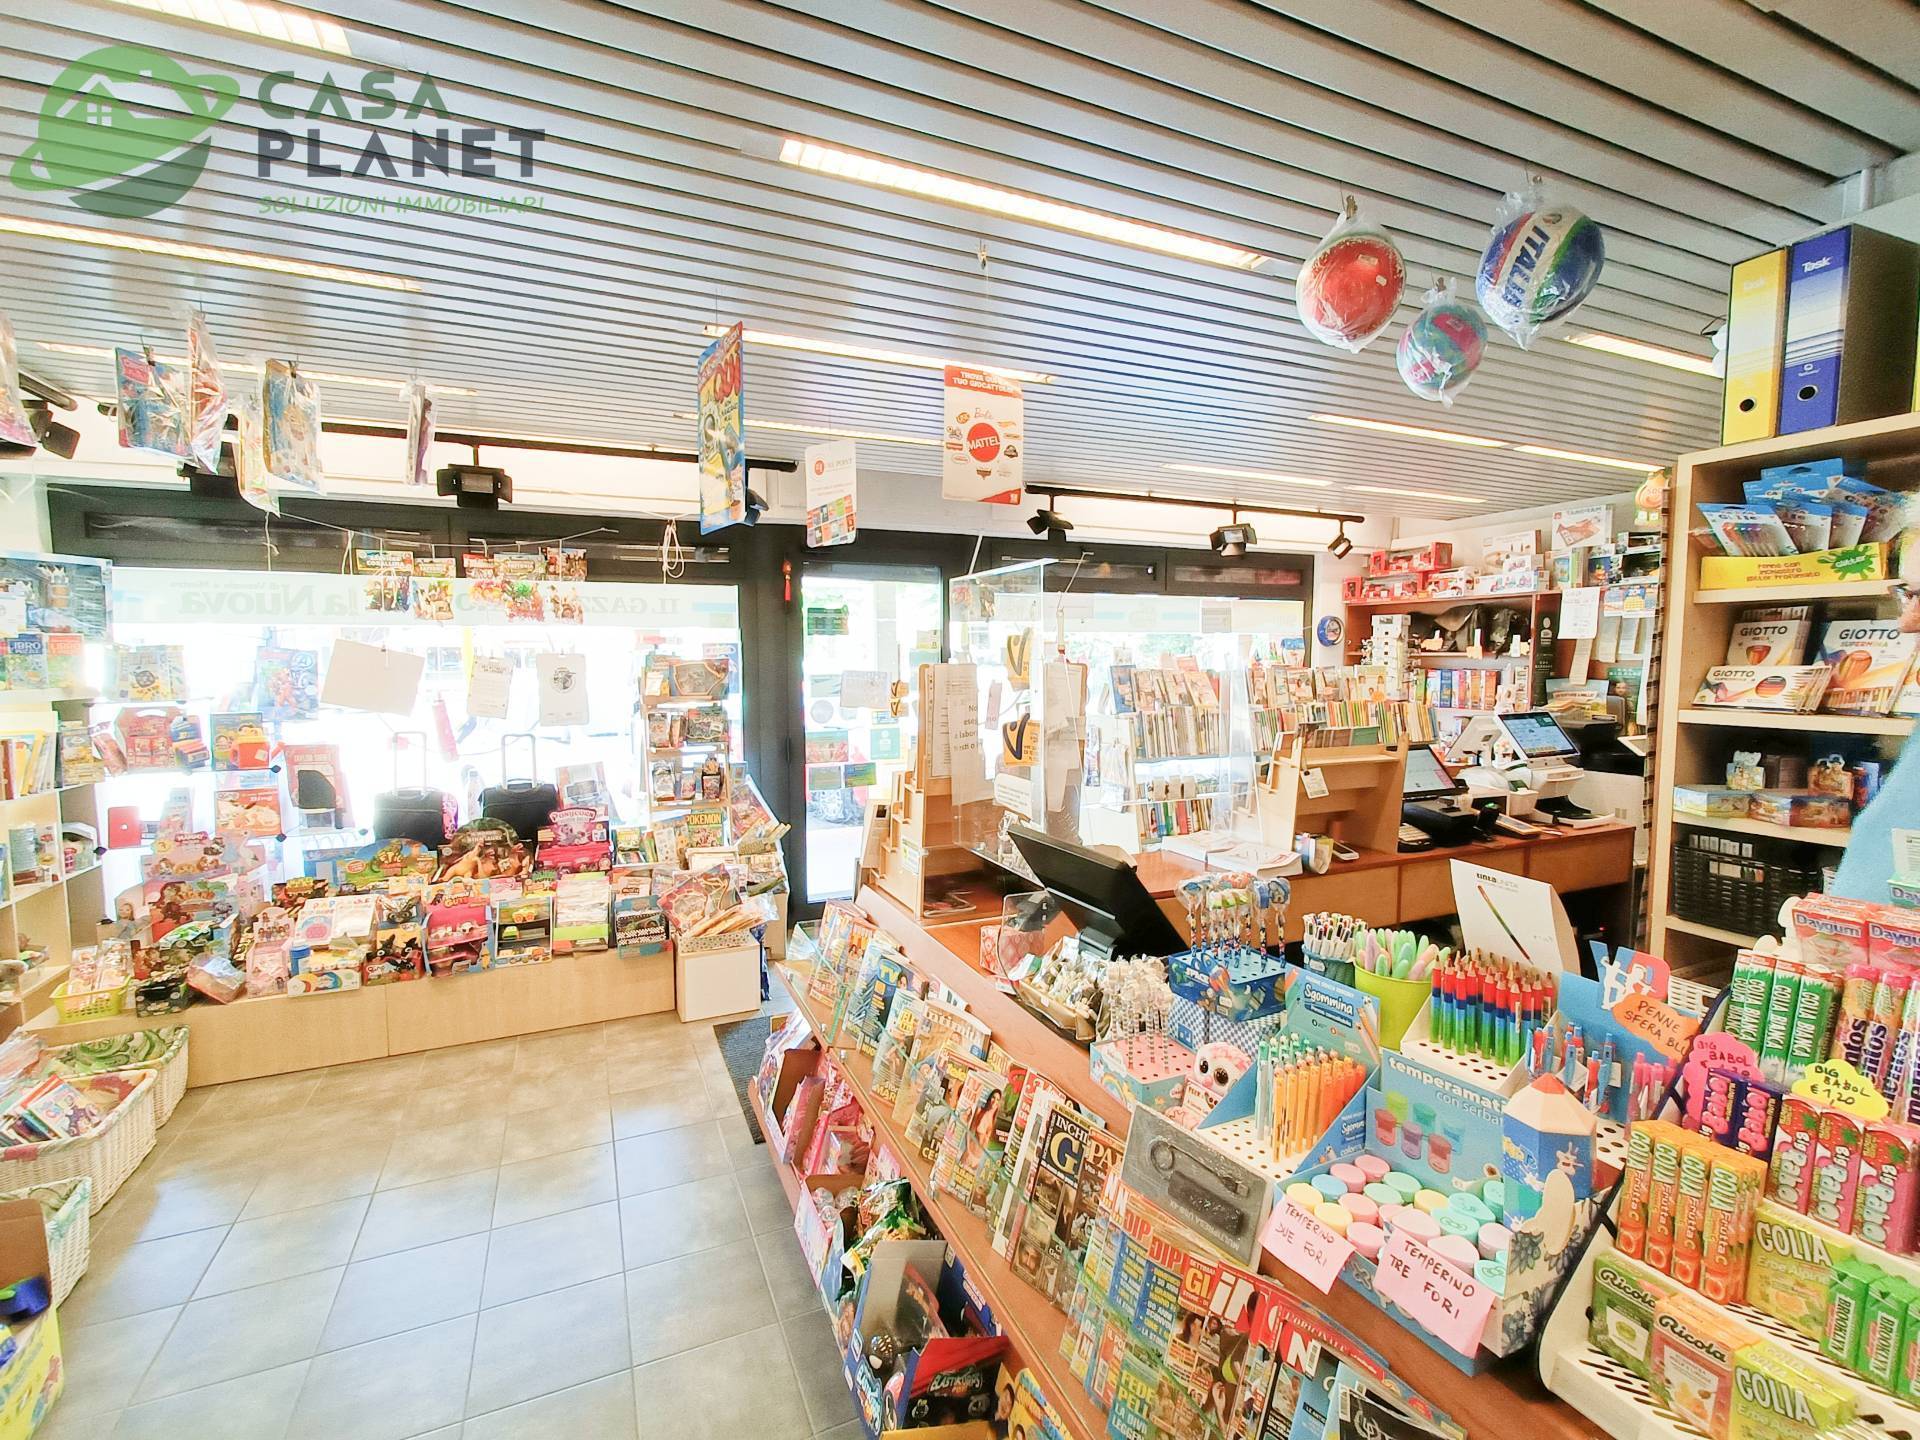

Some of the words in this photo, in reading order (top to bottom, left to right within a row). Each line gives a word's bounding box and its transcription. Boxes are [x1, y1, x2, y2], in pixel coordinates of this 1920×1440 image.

[1802, 256, 1832, 273] Task
[968, 436, 1000, 451] MATTEL
[1740, 625, 1788, 637] GIOTTO
[1839, 628, 1900, 641] GIOTTO
[1713, 669, 1755, 678] GIOTTO
[1892, 887, 1920, 906] Day
[1796, 913, 1860, 937] Daygum
[1871, 924, 1920, 947] Daygu
[1304, 983, 1354, 1017] Sgommina
[1638, 1000, 1680, 1034] PENNE
[1624, 1010, 1662, 1041] SFERA
[1765, 1012, 1788, 1050] BIANCA
[1792, 1020, 1816, 1058] BIANCA
[1844, 1017, 1869, 1066] ntos
[1708, 1051, 1752, 1067] BABOL
[1859, 1022, 1888, 1084] entos
[1814, 1065, 1839, 1078] BIG
[1823, 1077, 1872, 1098] BABOL
[1435, 1092, 1460, 1109] con
[1810, 1083, 1819, 1095] €
[1822, 1088, 1855, 1106] 1,20
[1631, 1170, 1644, 1210] Frutta
[1659, 1183, 1672, 1225] Frutta
[1286, 1203, 1335, 1244] TEMPERINO
[1686, 1197, 1700, 1243] Frutta
[1717, 1211, 1732, 1256] Frutta
[1304, 1242, 1328, 1266] FORI
[1404, 1240, 1475, 1297] TEMPERINO
[1390, 1254, 1411, 1278] TRE
[1423, 1281, 1461, 1319] FORI
[1601, 1269, 1656, 1309] Ricola
[1659, 1315, 1727, 1363] Ricola
[1831, 1297, 1851, 1354] BROOKLYN
[1870, 1316, 1895, 1377] BROOKLYN
